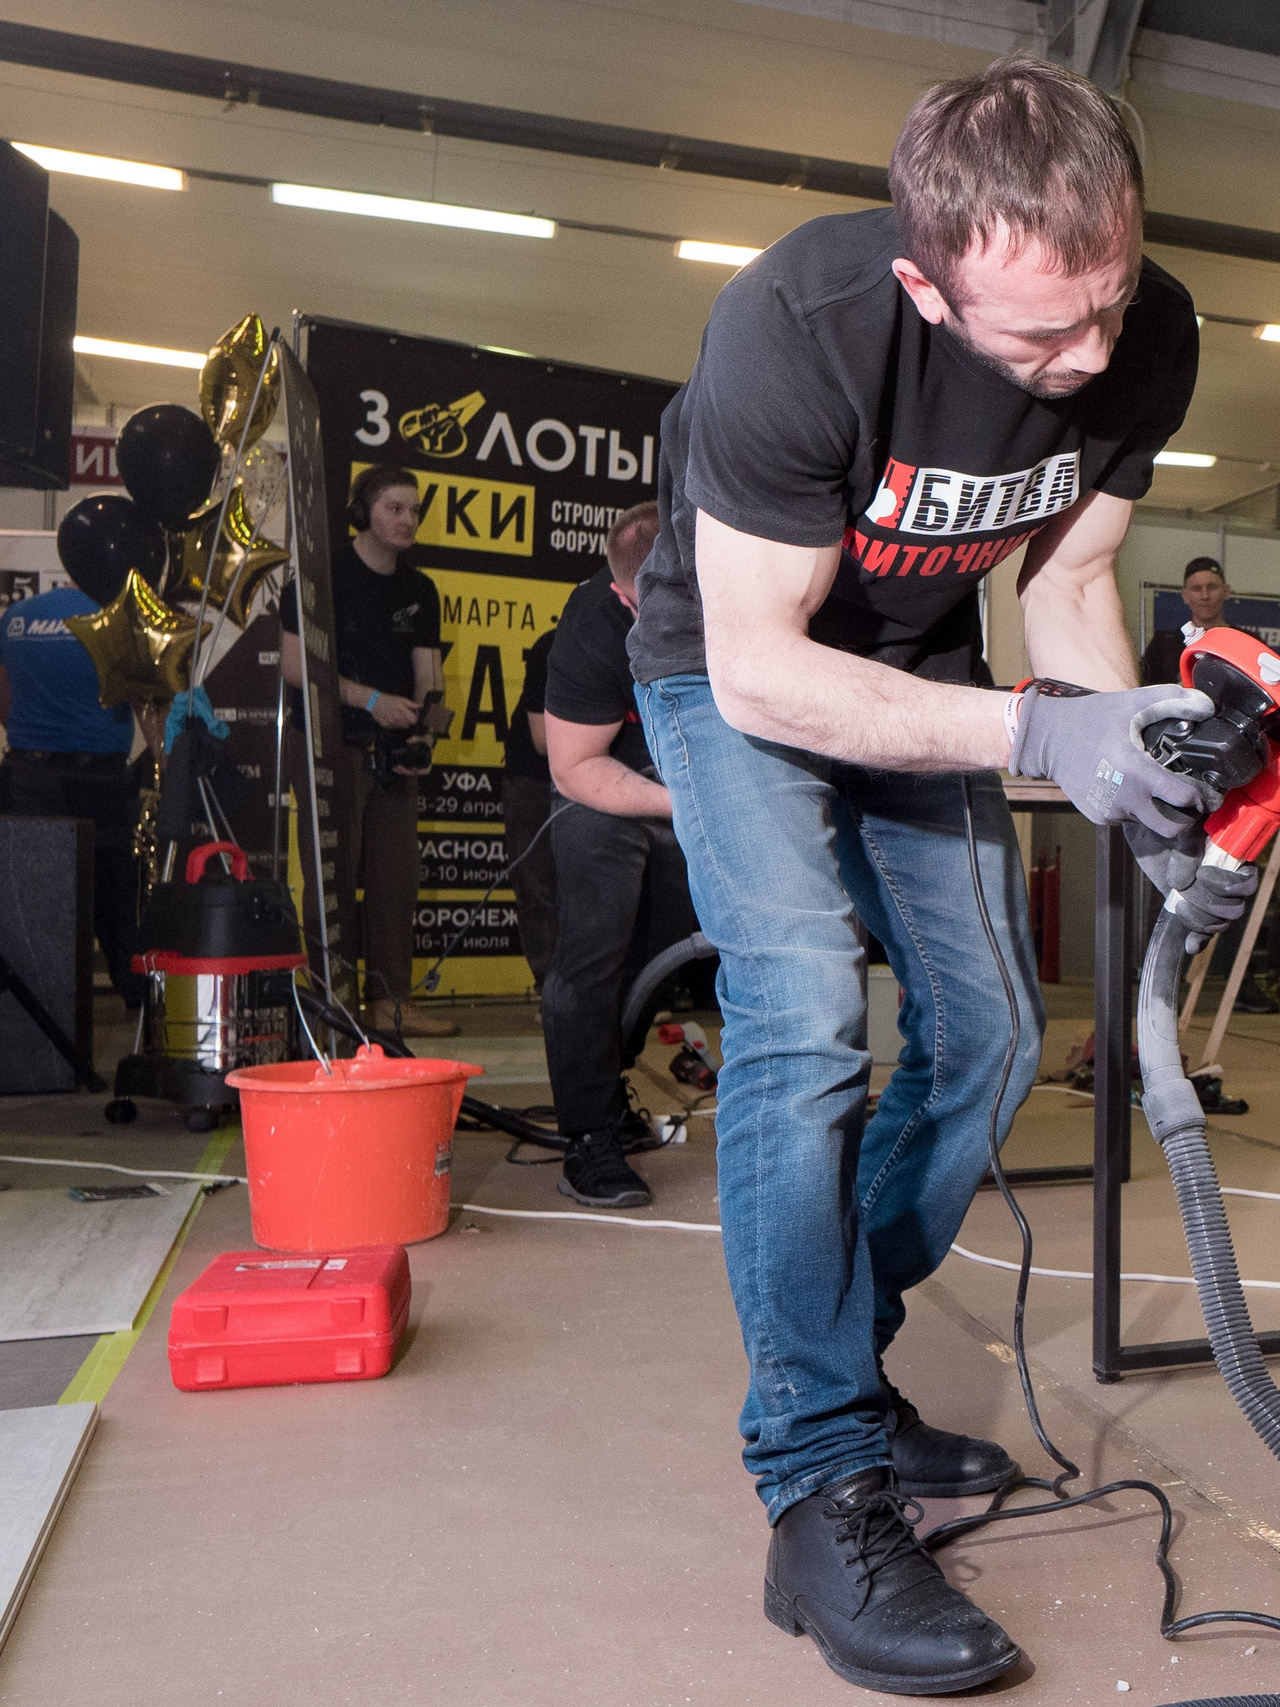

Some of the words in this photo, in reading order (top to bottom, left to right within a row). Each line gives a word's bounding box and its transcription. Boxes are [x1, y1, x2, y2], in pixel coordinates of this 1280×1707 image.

[910, 456, 1077, 532] БИТВА
[443, 595, 536, 631] МАРТА
[442, 772, 493, 792] УФА
[418, 839, 509, 862] АСНОД
[463, 869, 510, 881] июня
[414, 933, 459, 950] 16-17
[463, 936, 510, 949] июля
